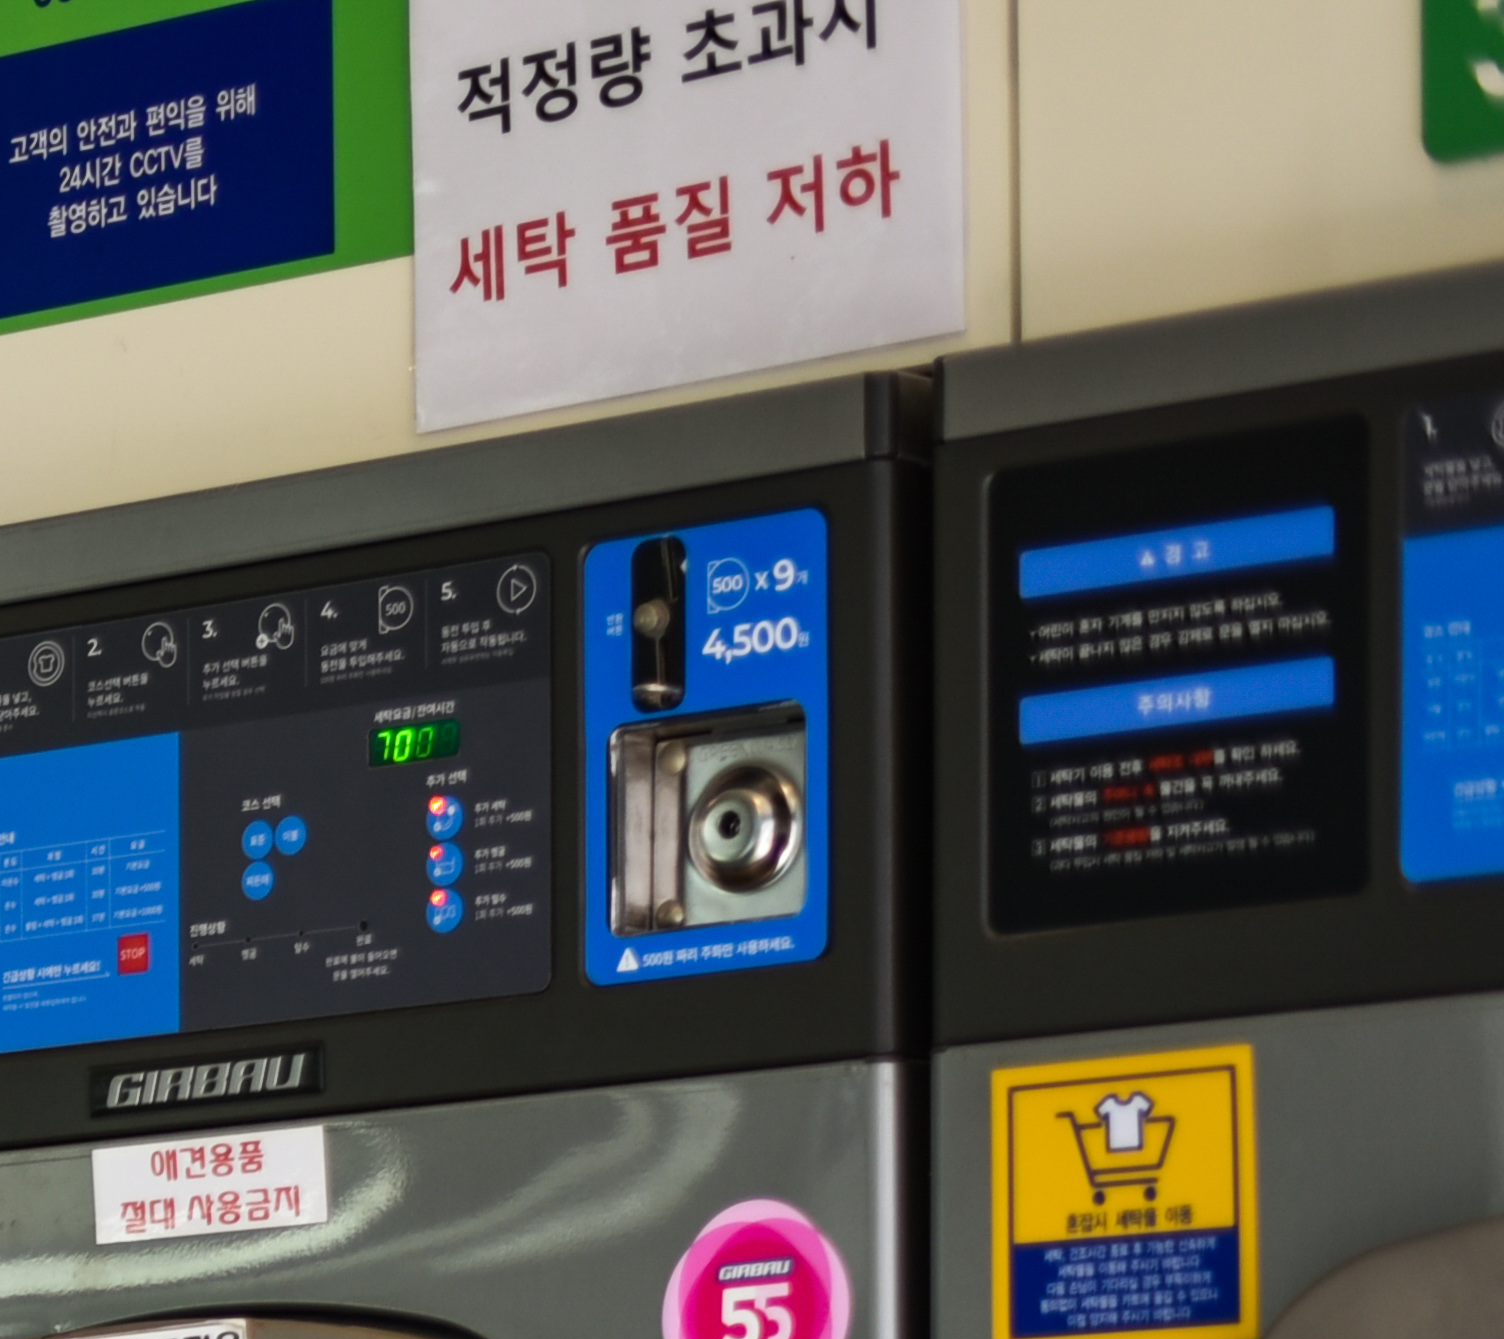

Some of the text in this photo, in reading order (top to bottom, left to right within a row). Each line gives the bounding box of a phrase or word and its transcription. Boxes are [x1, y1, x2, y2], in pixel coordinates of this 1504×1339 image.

[457, 26, 652, 133] 적정량
[8, 83, 256, 164] 고객의 안전과 편익을 위해
[59, 136, 205, 193] 24시간 CCTV를
[47, 174, 218, 239] 촬영하고 있습니다
[450, 142, 900, 302] 세탁 품질 저하
[711, 573, 745, 595] 500
[119, 946, 146, 962] STOP
[105, 1050, 306, 1110] GIRBAU
[147, 1139, 267, 1183] 애견용품
[119, 1184, 303, 1234] 절대 사용금지
[717, 1259, 794, 1283] GIRBAU
